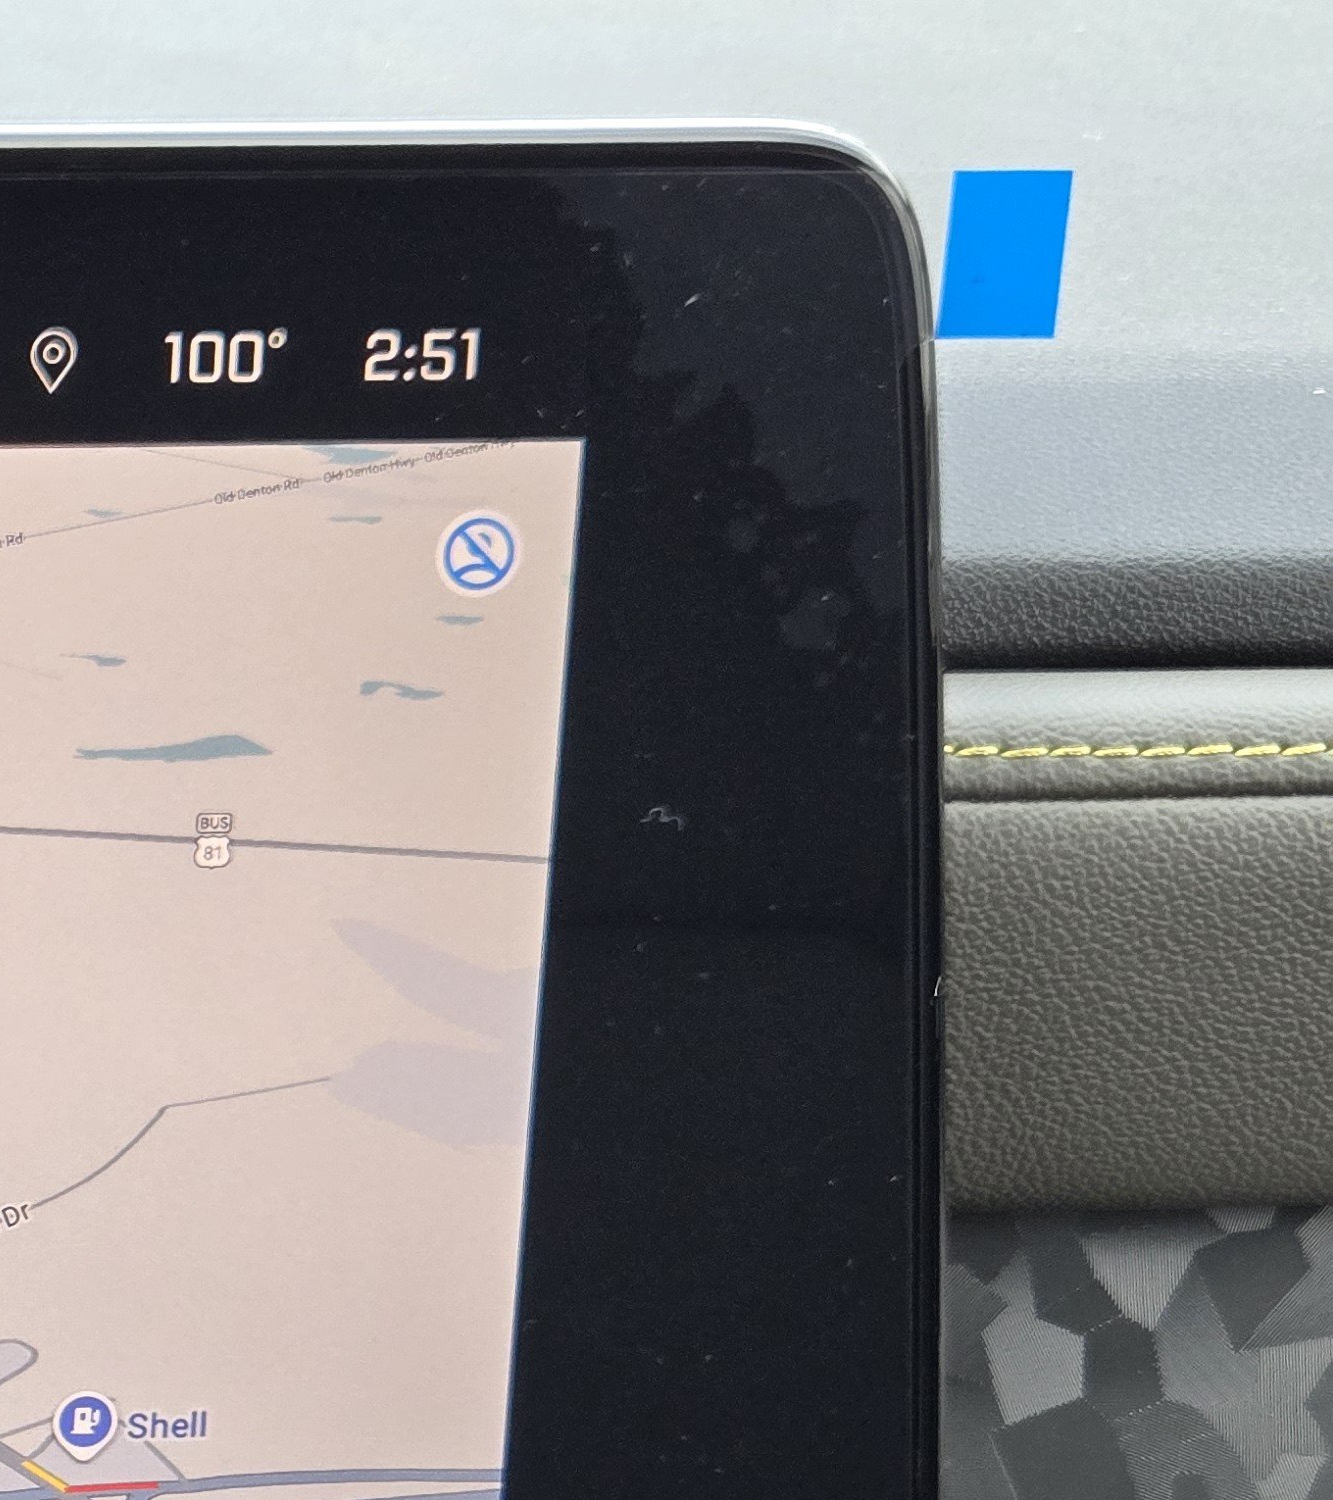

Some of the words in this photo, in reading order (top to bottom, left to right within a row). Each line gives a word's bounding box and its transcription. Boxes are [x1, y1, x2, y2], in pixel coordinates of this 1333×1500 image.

[164, 327, 288, 384] 100°
[363, 327, 480, 382] 2:51
[200, 817, 228, 830] BUS
[203, 845, 222, 861] 81
[2, 1204, 30, 1229] Dr
[127, 1411, 207, 1438] Shell
